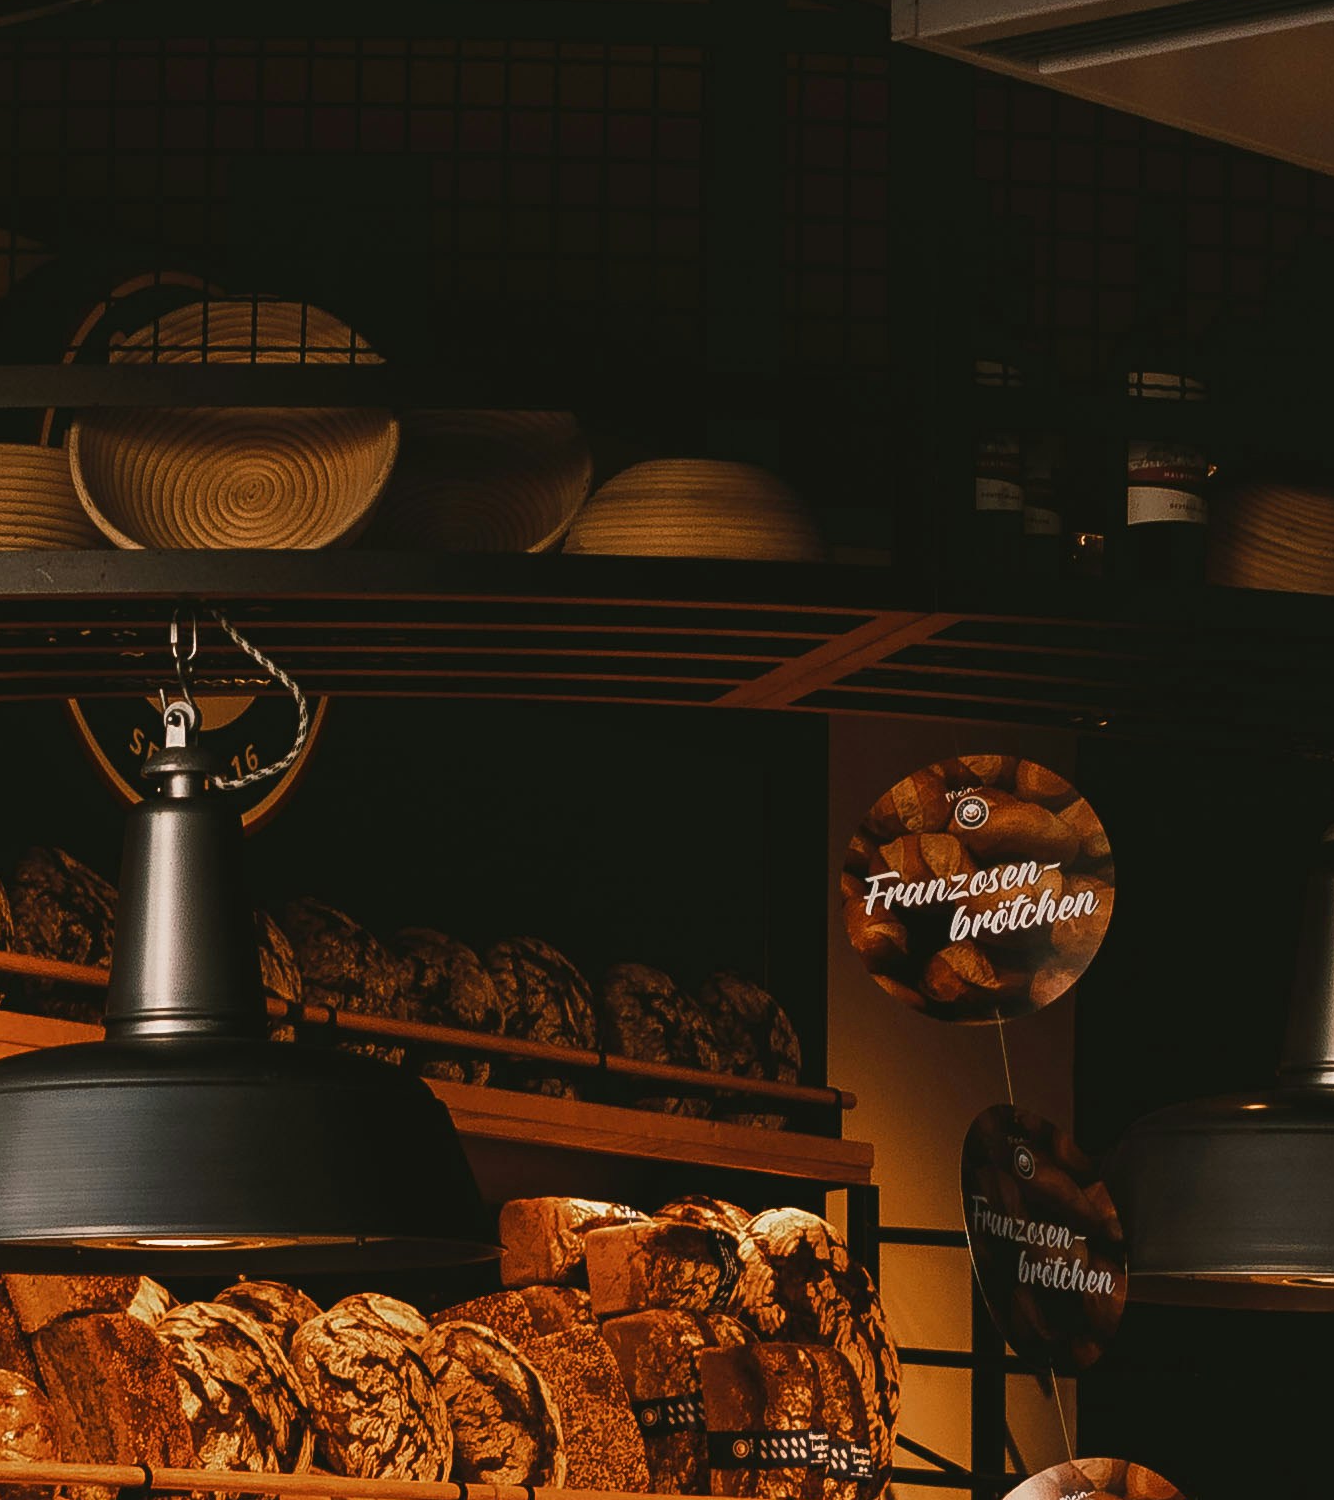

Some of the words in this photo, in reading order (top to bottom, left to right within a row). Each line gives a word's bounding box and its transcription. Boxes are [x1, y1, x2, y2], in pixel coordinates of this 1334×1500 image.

[863, 860, 1061, 916] Franzosen-
[949, 888, 1100, 942] brötchen
[972, 1195, 1087, 1248] Franzosen-
[1018, 1250, 1115, 1295] brötchen
